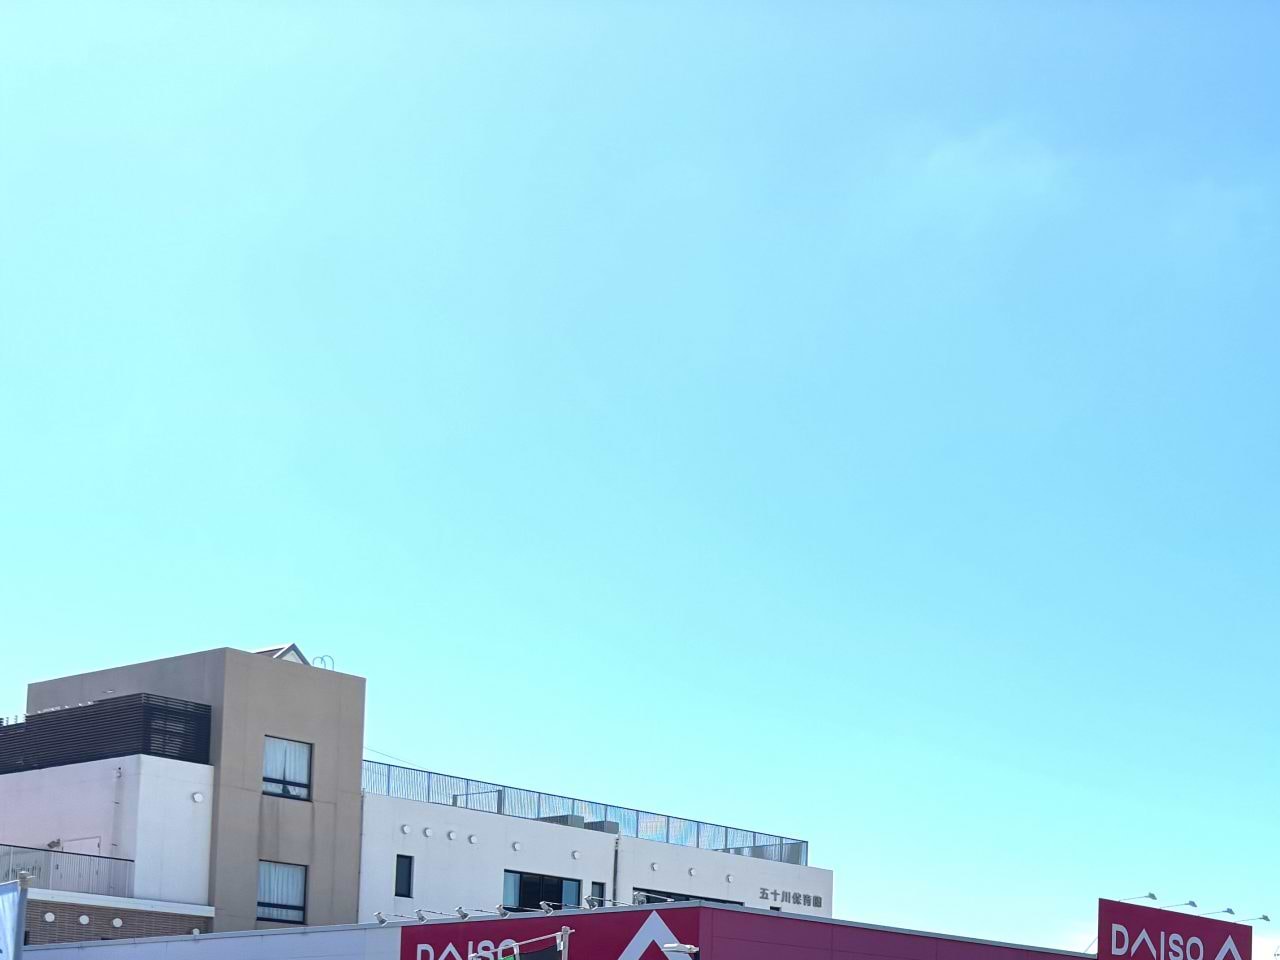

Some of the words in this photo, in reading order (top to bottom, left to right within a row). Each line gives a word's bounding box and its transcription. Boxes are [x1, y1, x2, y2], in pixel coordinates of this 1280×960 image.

[759, 887, 823, 907] 五十川保育園
